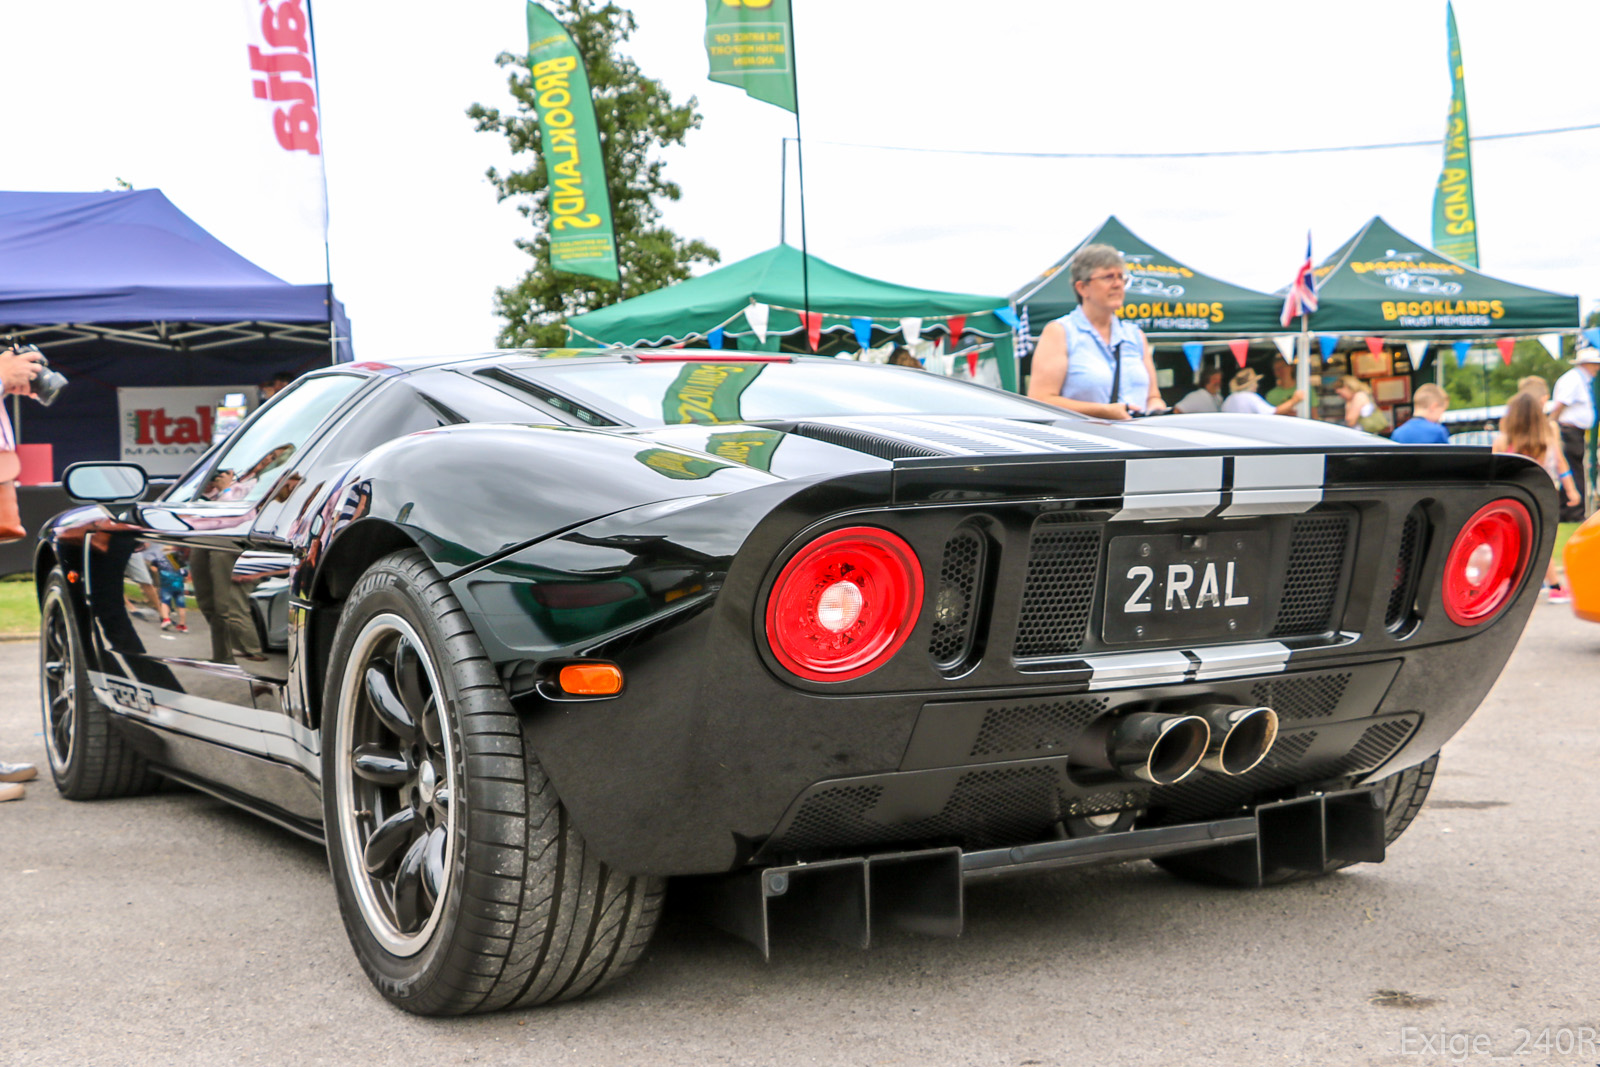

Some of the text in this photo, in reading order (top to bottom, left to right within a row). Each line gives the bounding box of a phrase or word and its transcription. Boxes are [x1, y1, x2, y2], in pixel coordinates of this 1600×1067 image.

[1114, 302, 1224, 323] ROOKLANDS
[1381, 300, 1505, 321] BROOKLANDS
[1399, 314, 1491, 327] TRUST MEMBERS
[1152, 317, 1210, 330] MEMBERS
[134, 405, 214, 446] Ital
[124, 446, 208, 456] MAGA
[1124, 561, 1250, 614] 2 RAL
